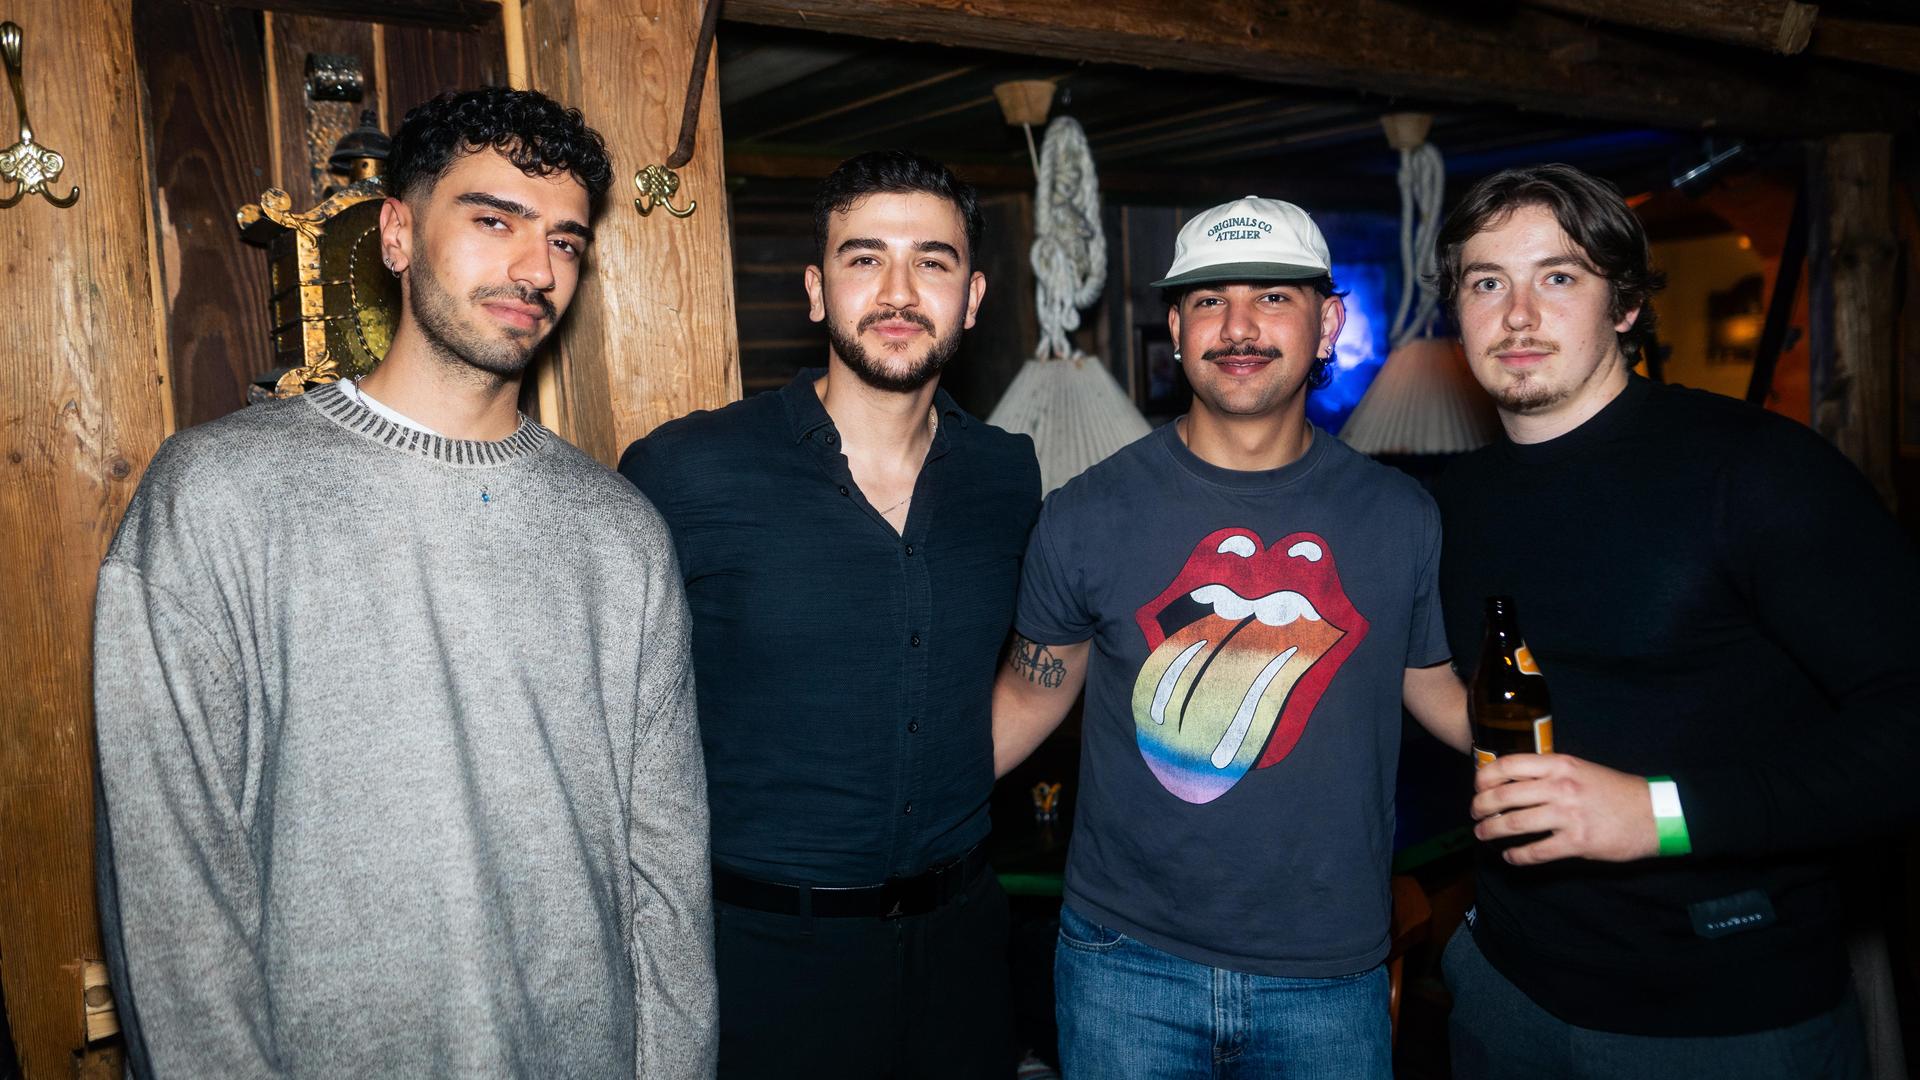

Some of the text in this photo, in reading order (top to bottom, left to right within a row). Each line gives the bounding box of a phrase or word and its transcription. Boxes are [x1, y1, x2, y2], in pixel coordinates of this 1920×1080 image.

[1207, 217, 1272, 237] ORIGINALS CO.
[1215, 230, 1261, 241] ATELIER
